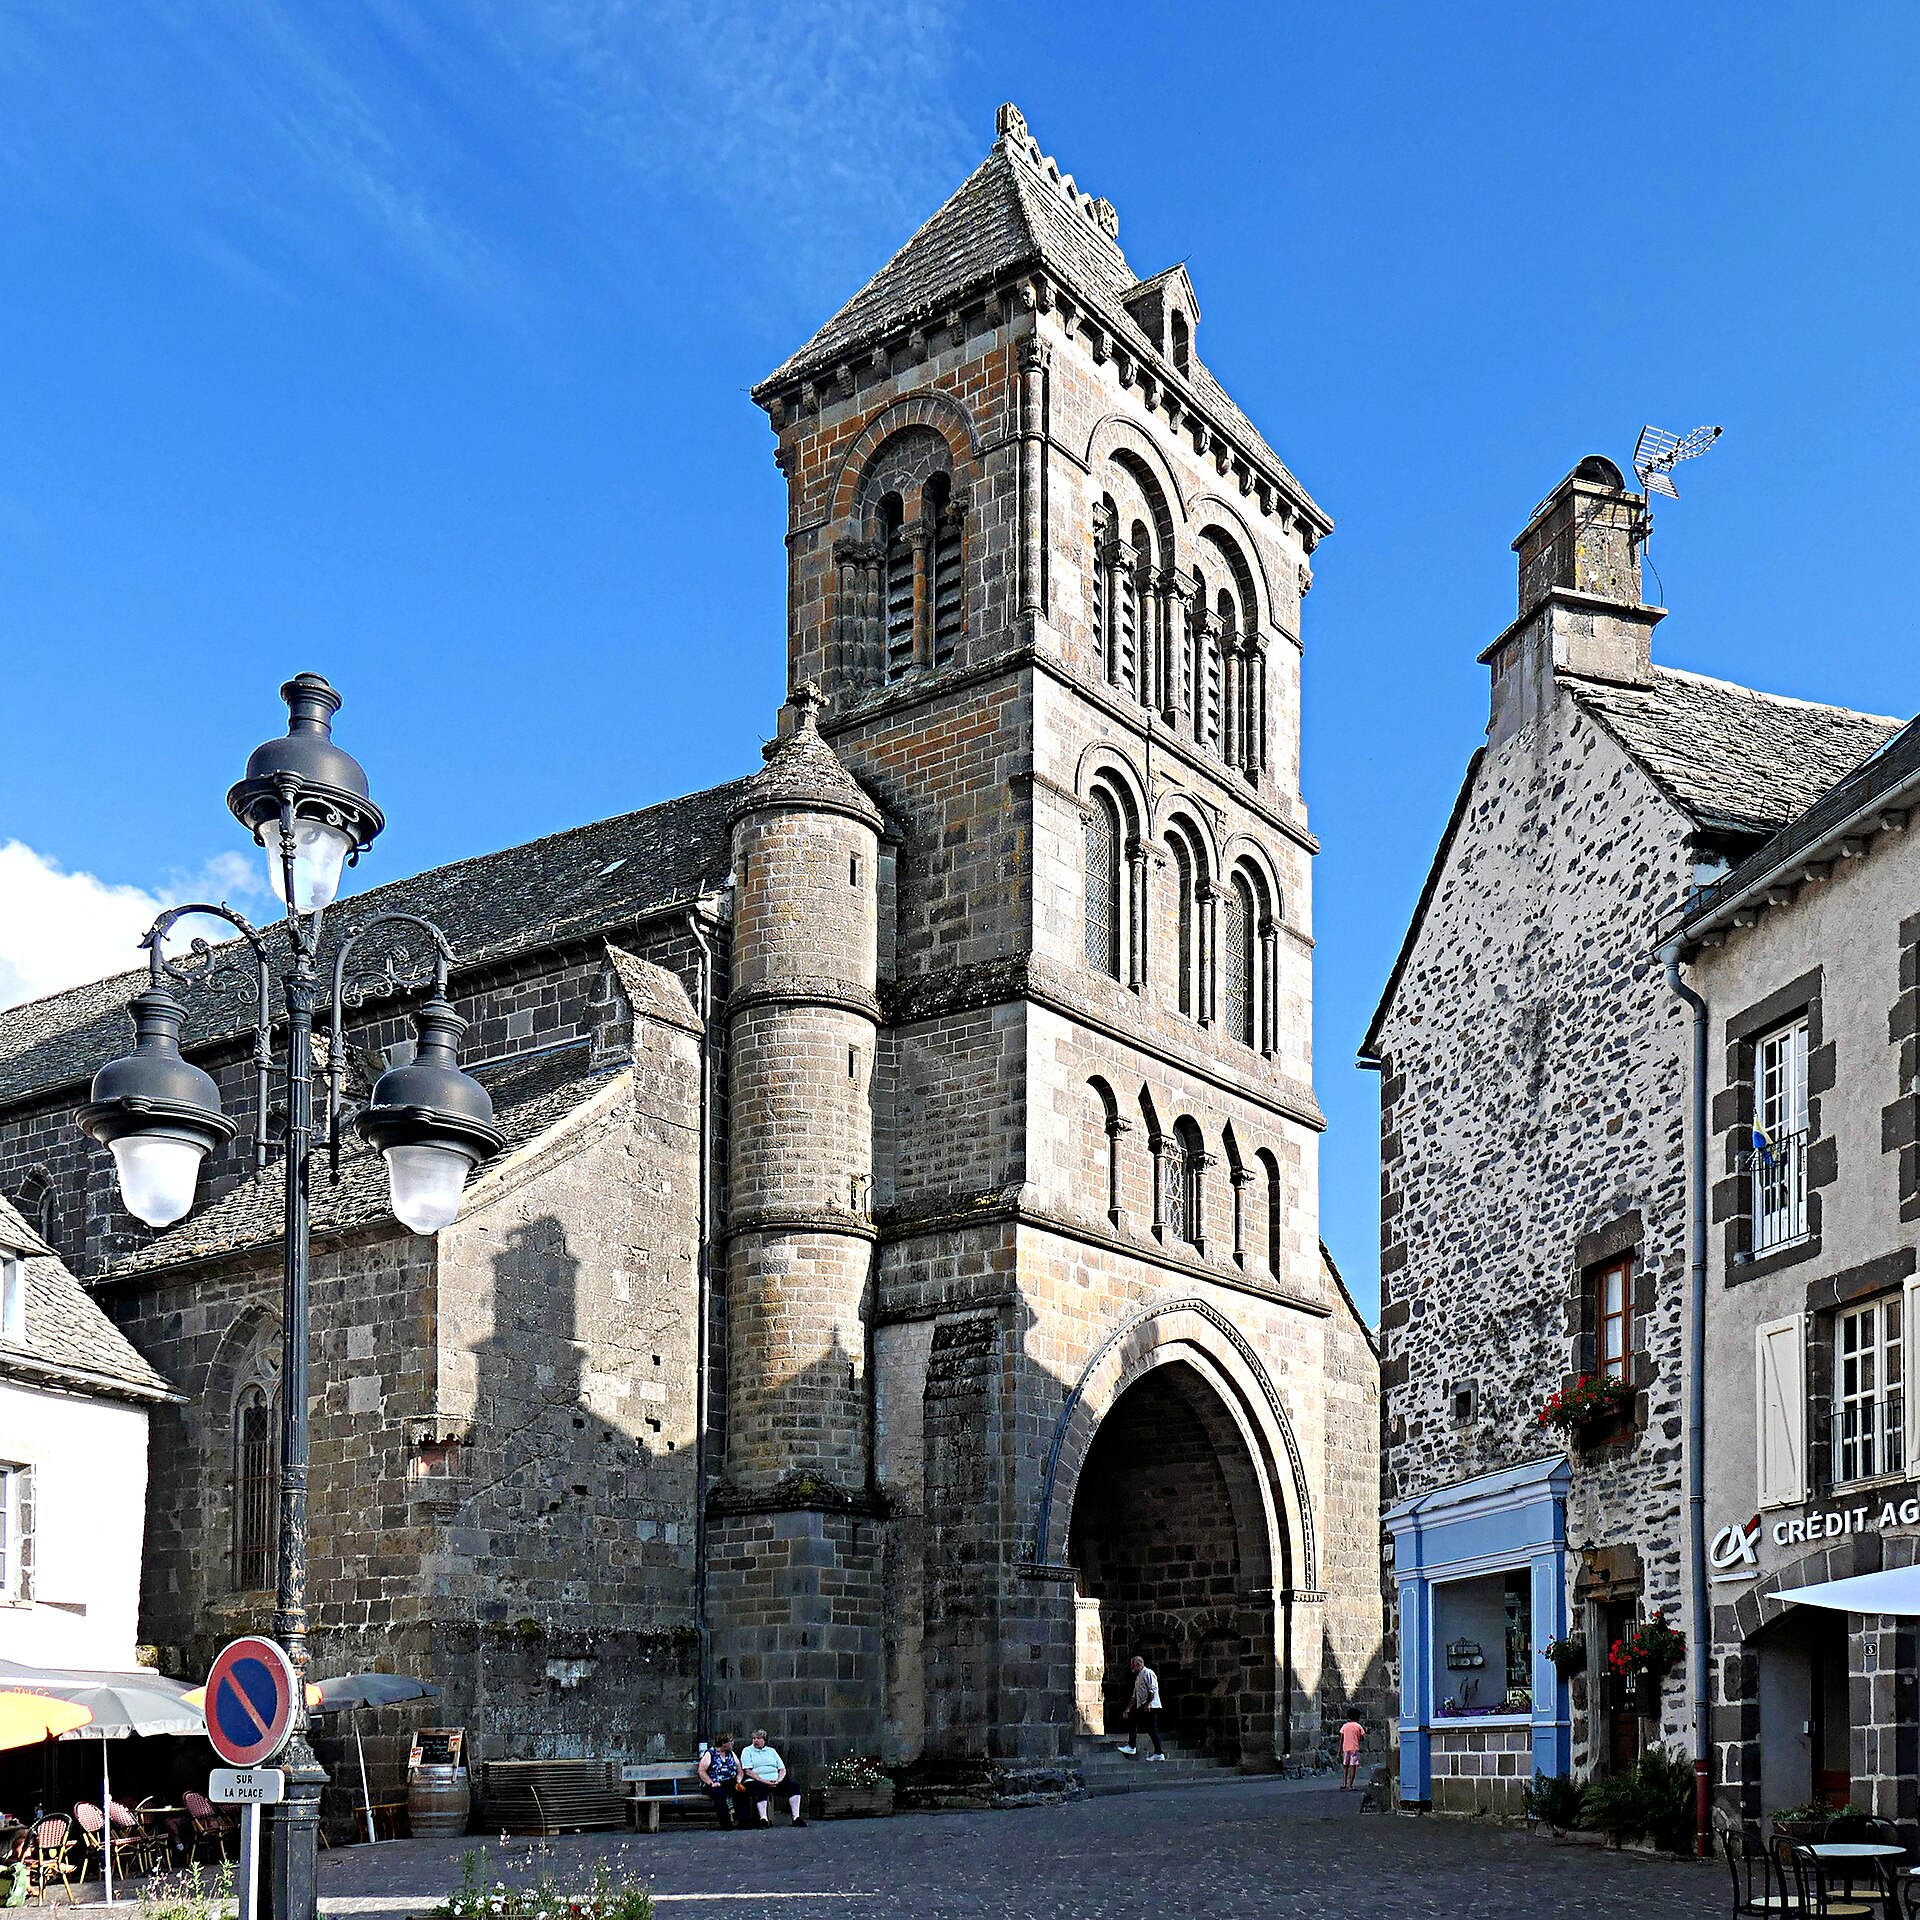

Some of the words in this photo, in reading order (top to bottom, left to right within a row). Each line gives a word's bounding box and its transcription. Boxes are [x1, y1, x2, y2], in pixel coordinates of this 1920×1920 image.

[1772, 1506, 1869, 1547] CRÉDIT
[236, 1774, 253, 1785] SUR
[224, 1788, 235, 1798] LA
[238, 1788, 264, 1798] PLACE
